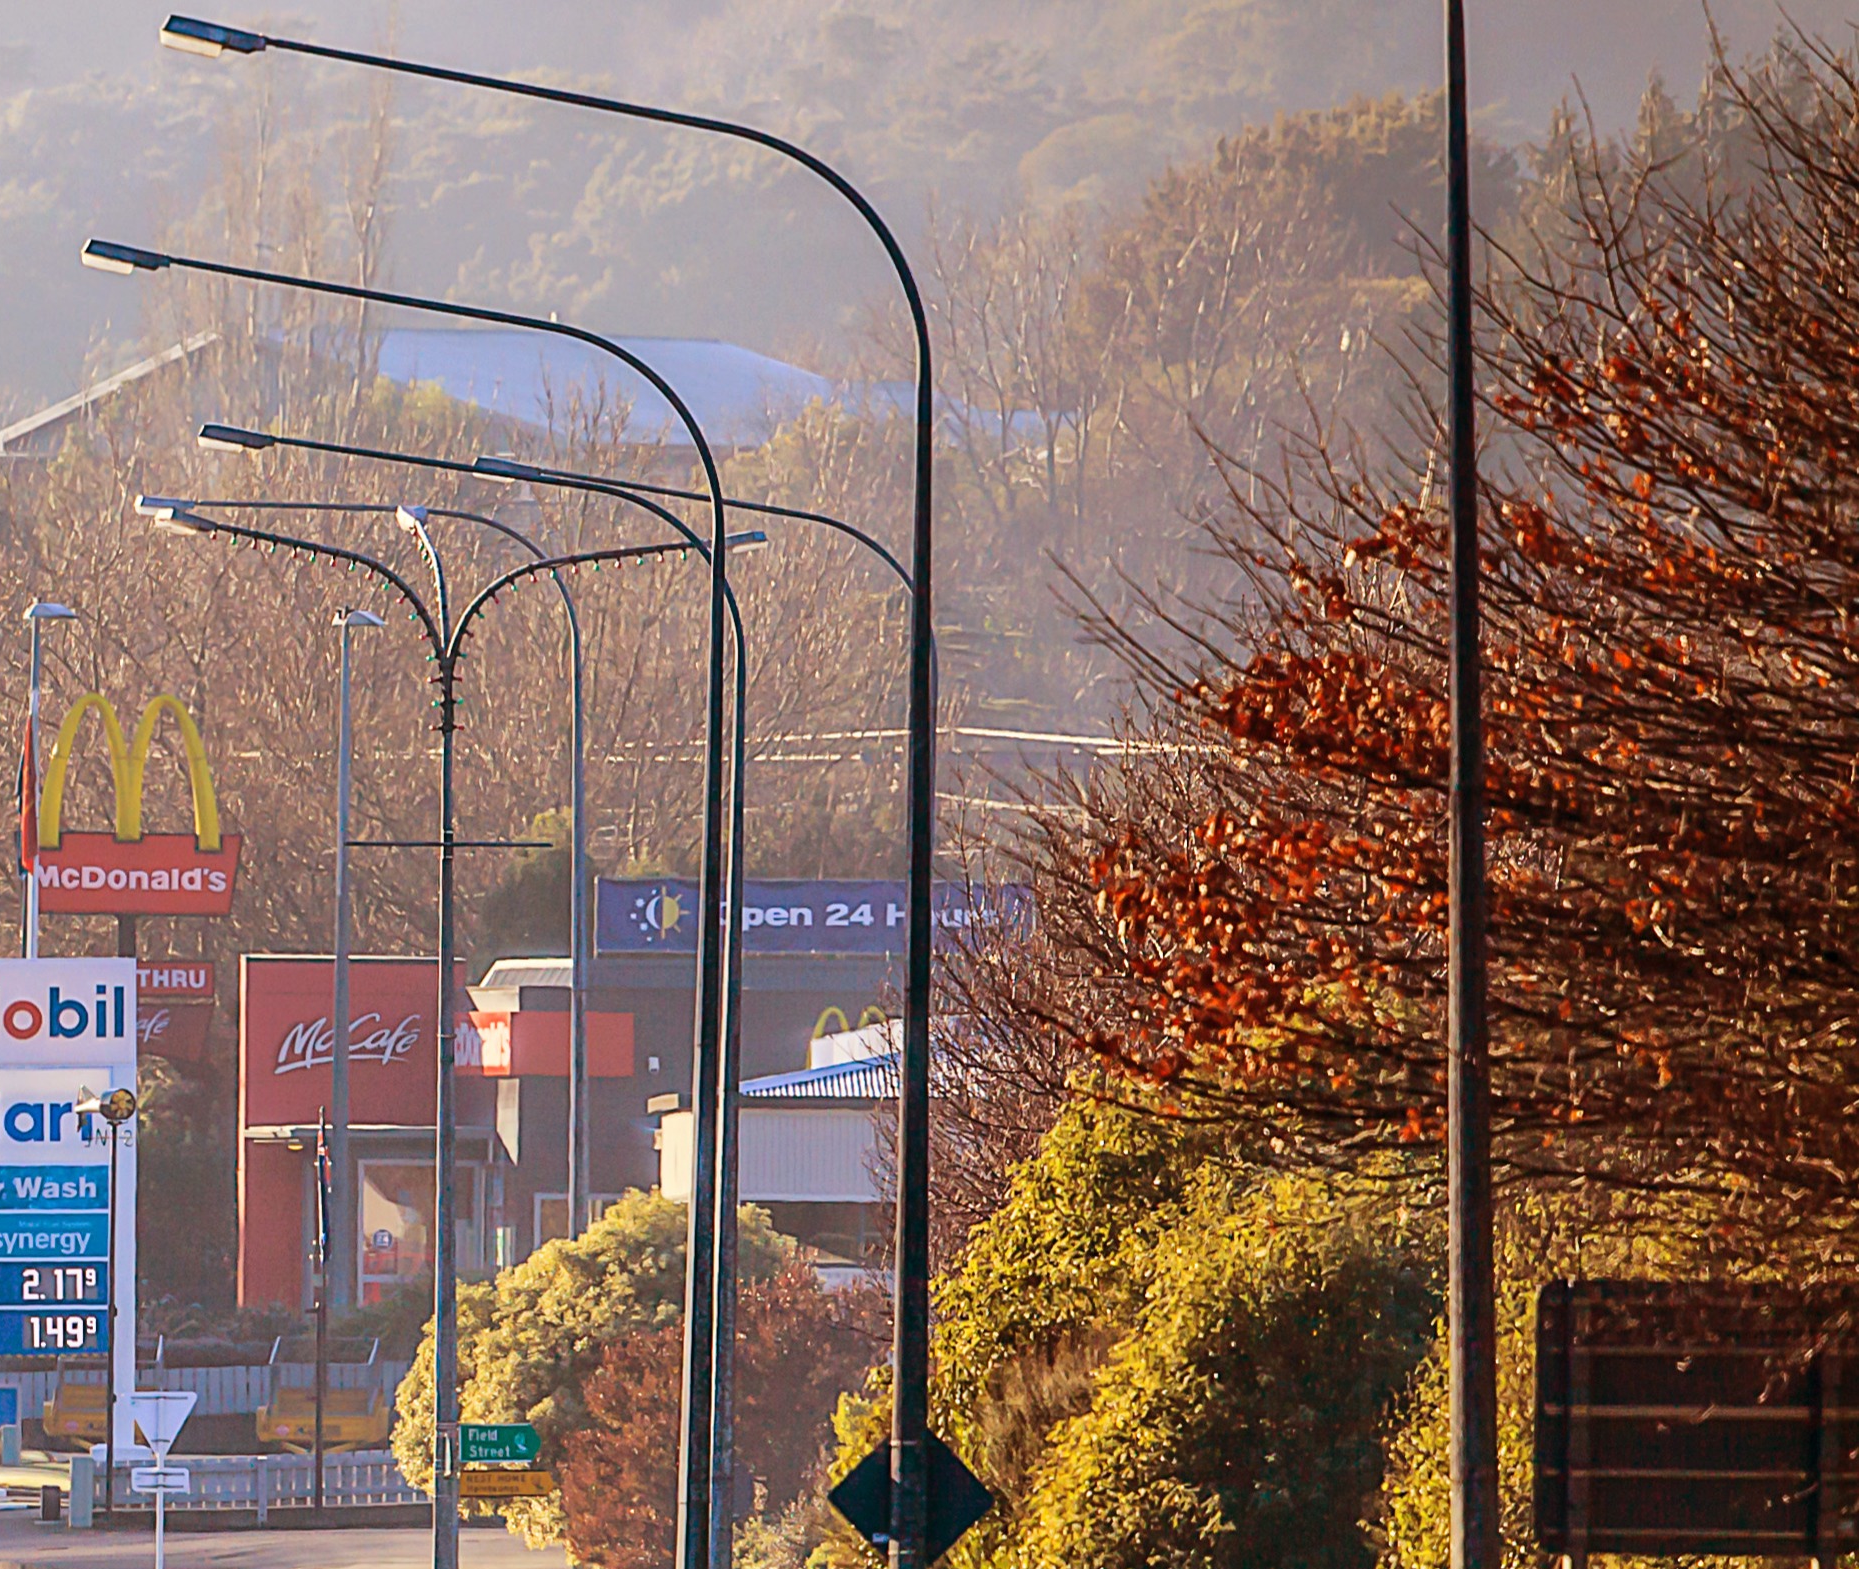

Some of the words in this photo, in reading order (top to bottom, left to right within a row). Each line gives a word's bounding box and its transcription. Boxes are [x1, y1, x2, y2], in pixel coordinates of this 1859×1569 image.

[38, 864, 227, 892] McDonald's
[825, 902, 874, 926] 24
[136, 969, 206, 989] THRU
[13, 1175, 97, 1199] Wash
[467, 1428, 498, 1441] Field
[469, 1444, 511, 1458] Street
